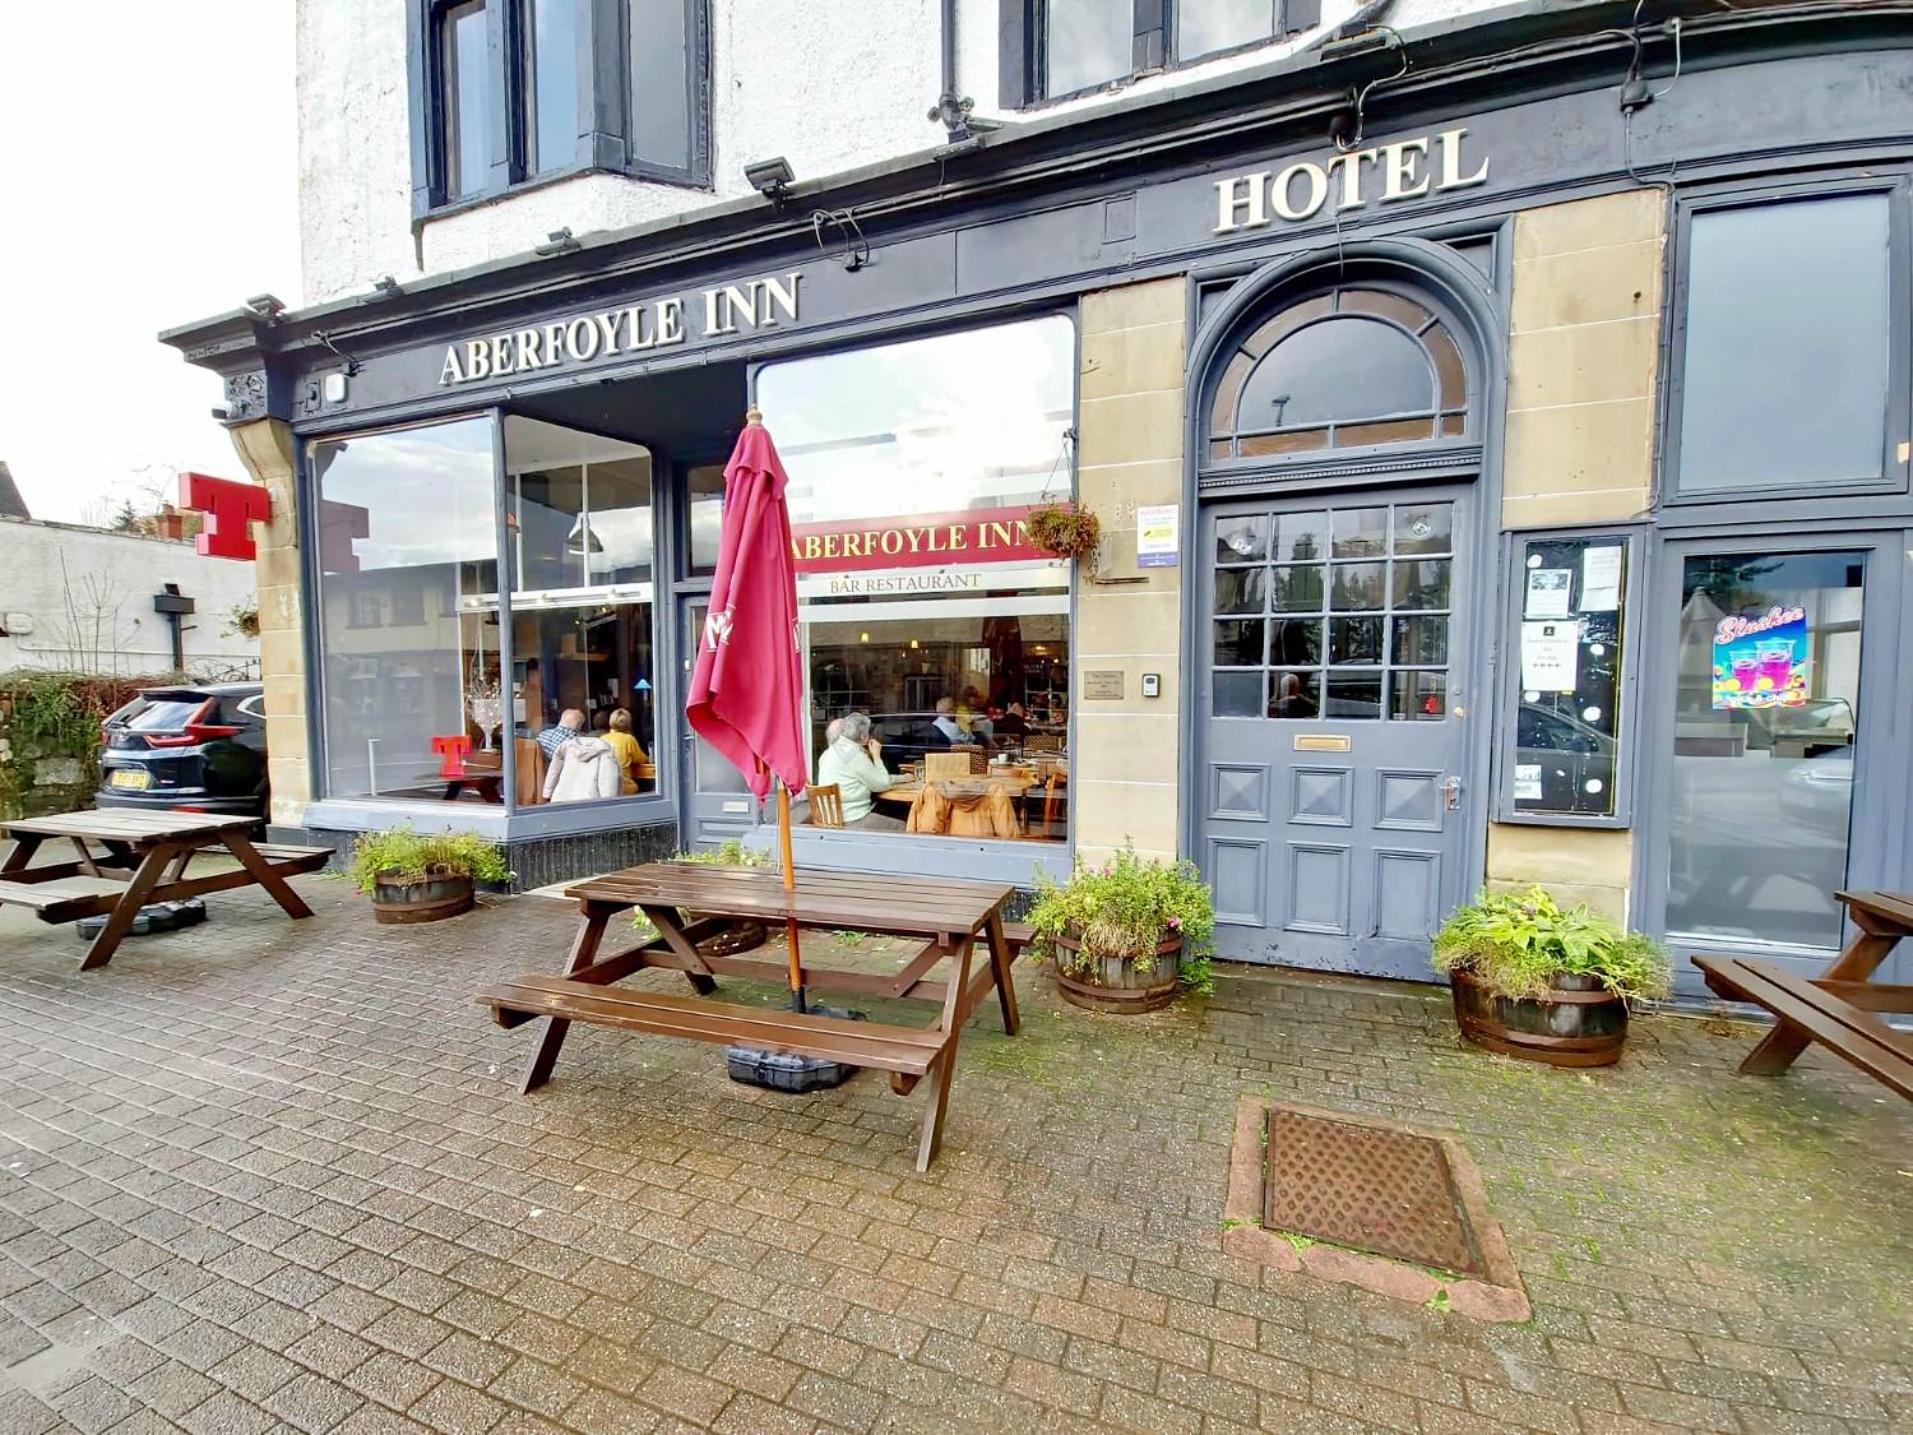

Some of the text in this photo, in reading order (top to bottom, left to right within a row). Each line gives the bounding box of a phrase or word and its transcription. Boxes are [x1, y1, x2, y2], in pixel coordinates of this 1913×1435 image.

[1213, 128, 1489, 233] HOTEL
[439, 272, 802, 385] ABERFOYLE INN
[830, 573, 982, 594] BAR RESTAURANT
